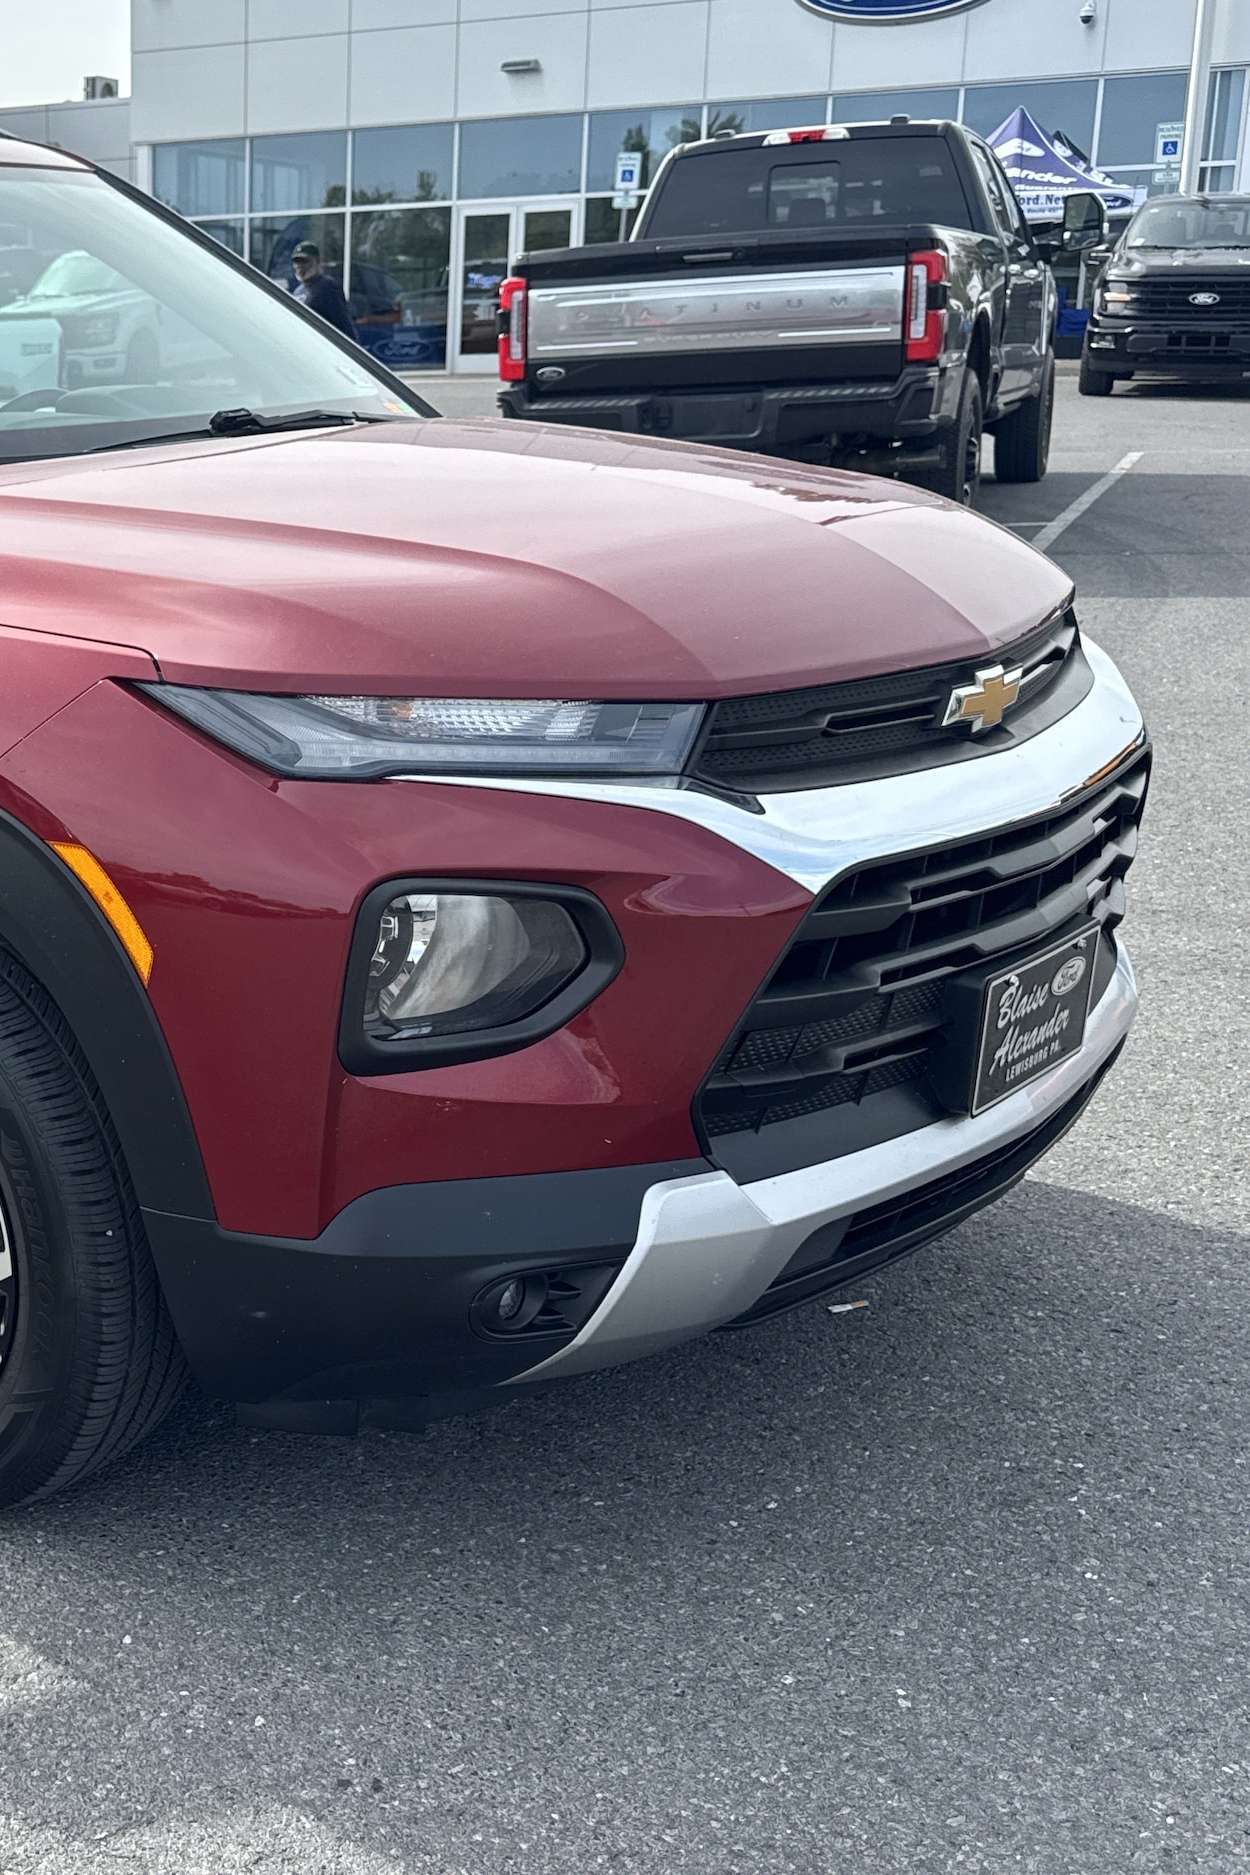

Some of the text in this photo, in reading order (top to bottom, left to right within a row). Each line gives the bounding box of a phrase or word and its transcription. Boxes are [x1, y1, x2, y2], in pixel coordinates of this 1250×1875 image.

[997, 982, 1050, 1029] Blaise
[989, 1003, 1070, 1076] Alexander
[1005, 1045, 1049, 1082] LEWISBURG
